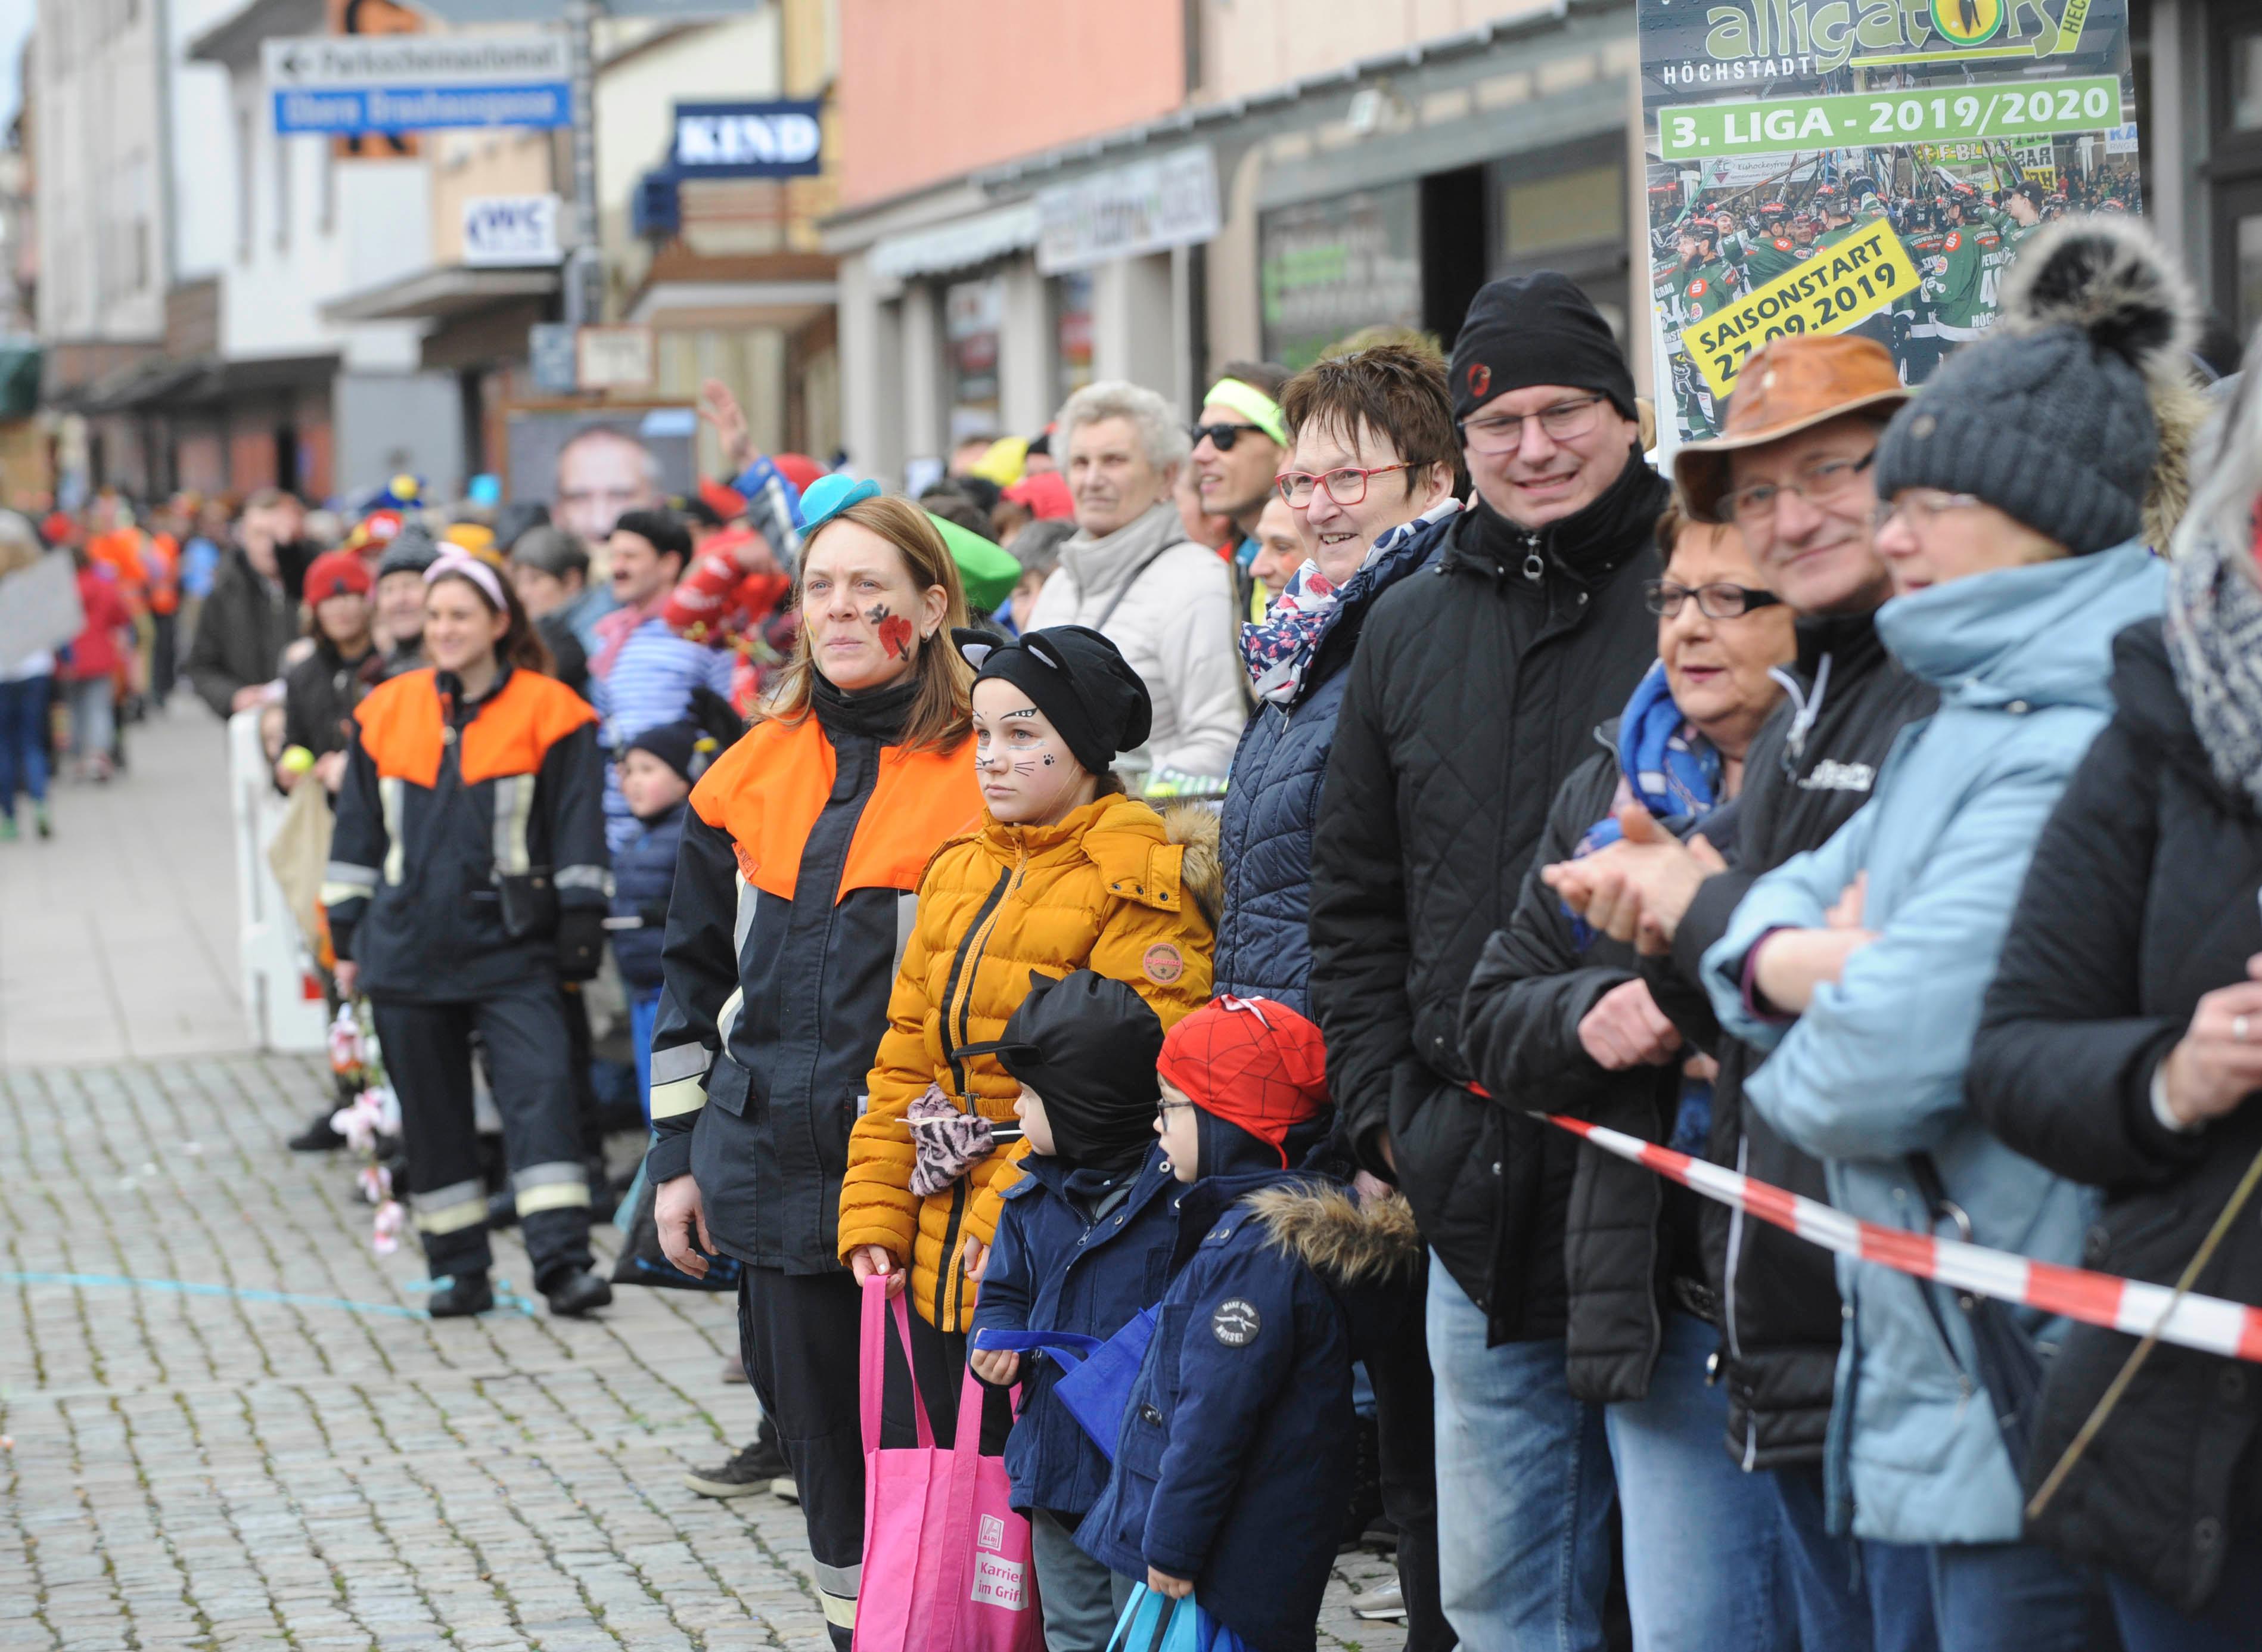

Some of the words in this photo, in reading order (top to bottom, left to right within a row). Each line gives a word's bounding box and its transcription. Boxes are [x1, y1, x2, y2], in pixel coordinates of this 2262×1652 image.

[1664, 57, 1810, 85] HÖCHSTADT
[1671, 117, 1710, 148] 3.
[1724, 107, 1834, 144] LIGA
[1869, 88, 2109, 135] 2019/2020
[678, 113, 821, 165] KIND
[1699, 234, 1883, 354] SAISONSTART
[1222, 1301, 1240, 1312] MAKE
[983, 1535, 997, 1543] ALDI
[978, 1580, 991, 1595] im
